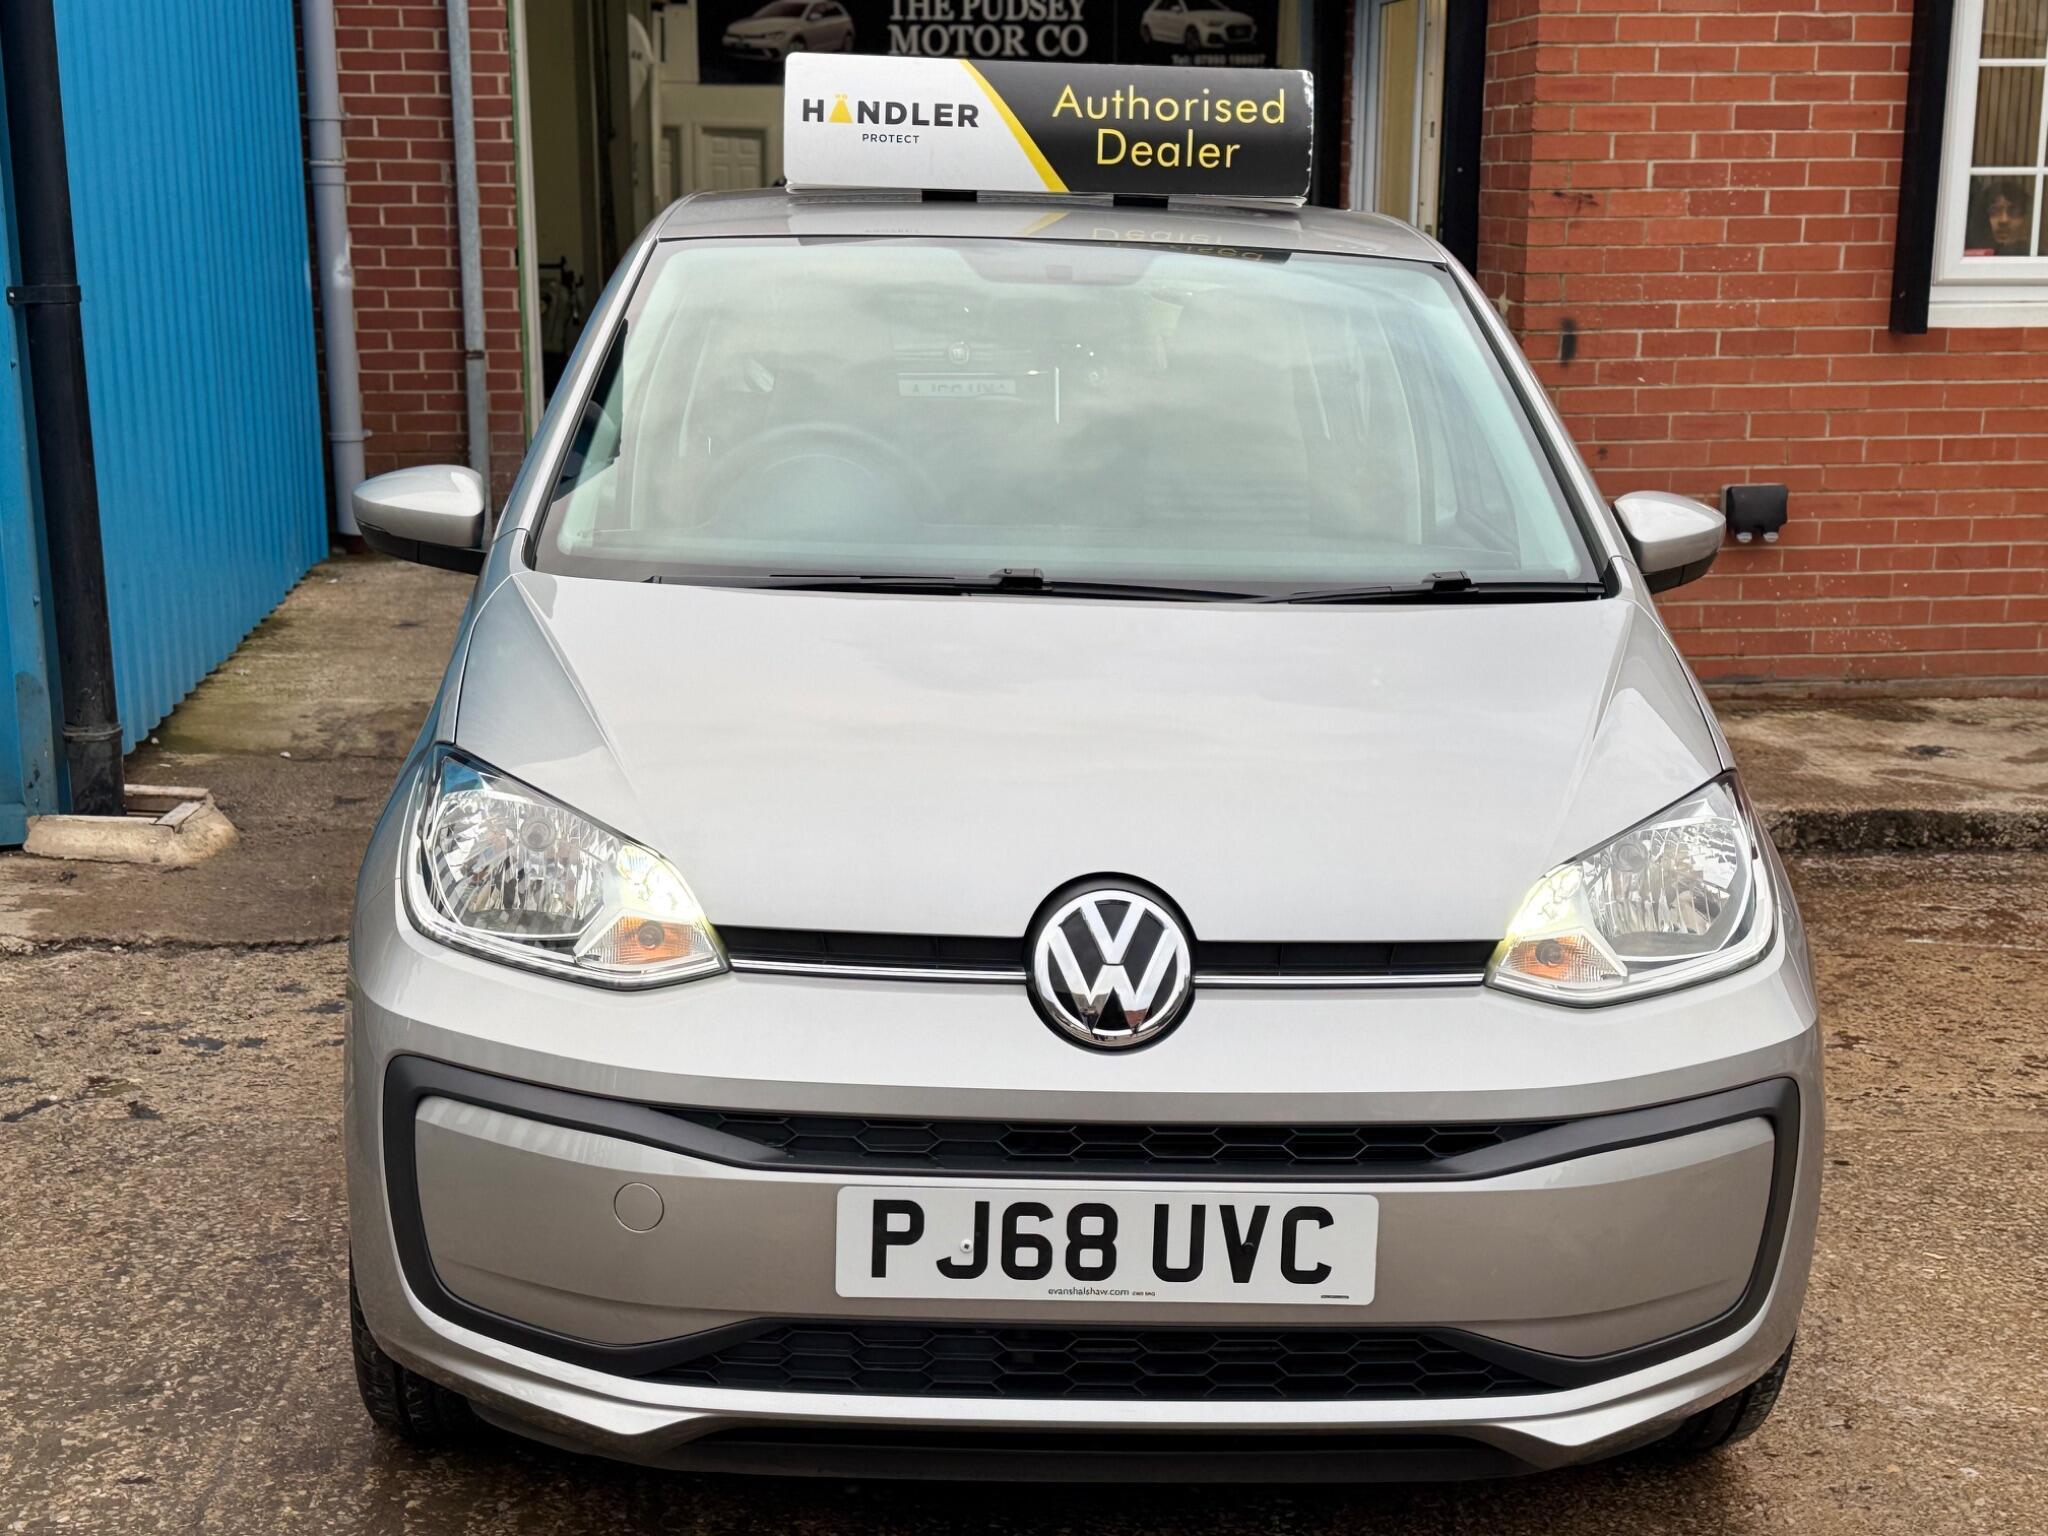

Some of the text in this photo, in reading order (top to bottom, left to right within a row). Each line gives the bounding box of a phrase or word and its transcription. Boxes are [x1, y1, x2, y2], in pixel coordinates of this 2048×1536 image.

[890, 0, 1084, 21] THE PUDSEY
[888, 24, 1088, 56] MOTOR CO
[1052, 84, 1285, 124] Authorised
[862, 133, 920, 144] PROTECT
[1097, 129, 1240, 168] Dealer
[871, 1199, 1334, 1284] PJ68 UVC
[1048, 1287, 1129, 1296] evanshalshaw.com
